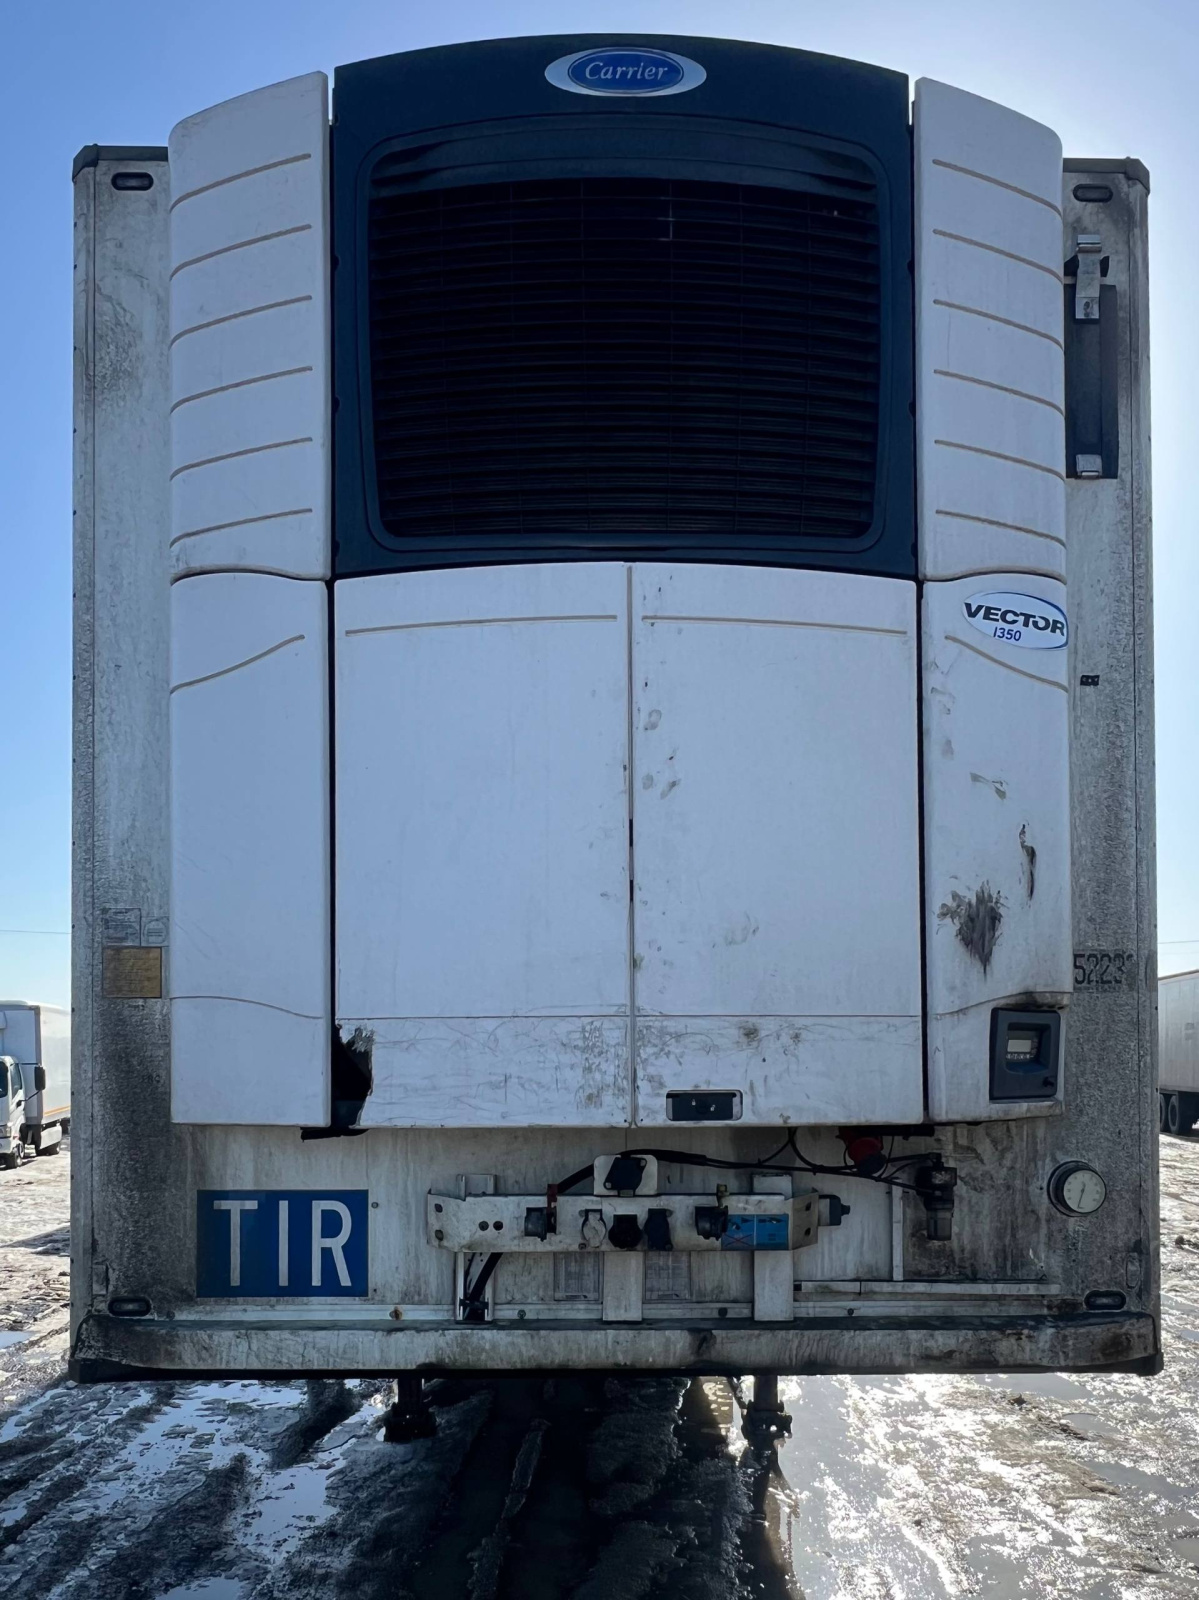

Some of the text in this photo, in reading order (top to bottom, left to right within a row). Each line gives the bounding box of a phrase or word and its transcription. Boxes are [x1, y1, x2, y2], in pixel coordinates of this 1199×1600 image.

[585, 61, 668, 80] Carrier
[964, 602, 1065, 636] VECTOR
[213, 1200, 352, 1286] TIR
